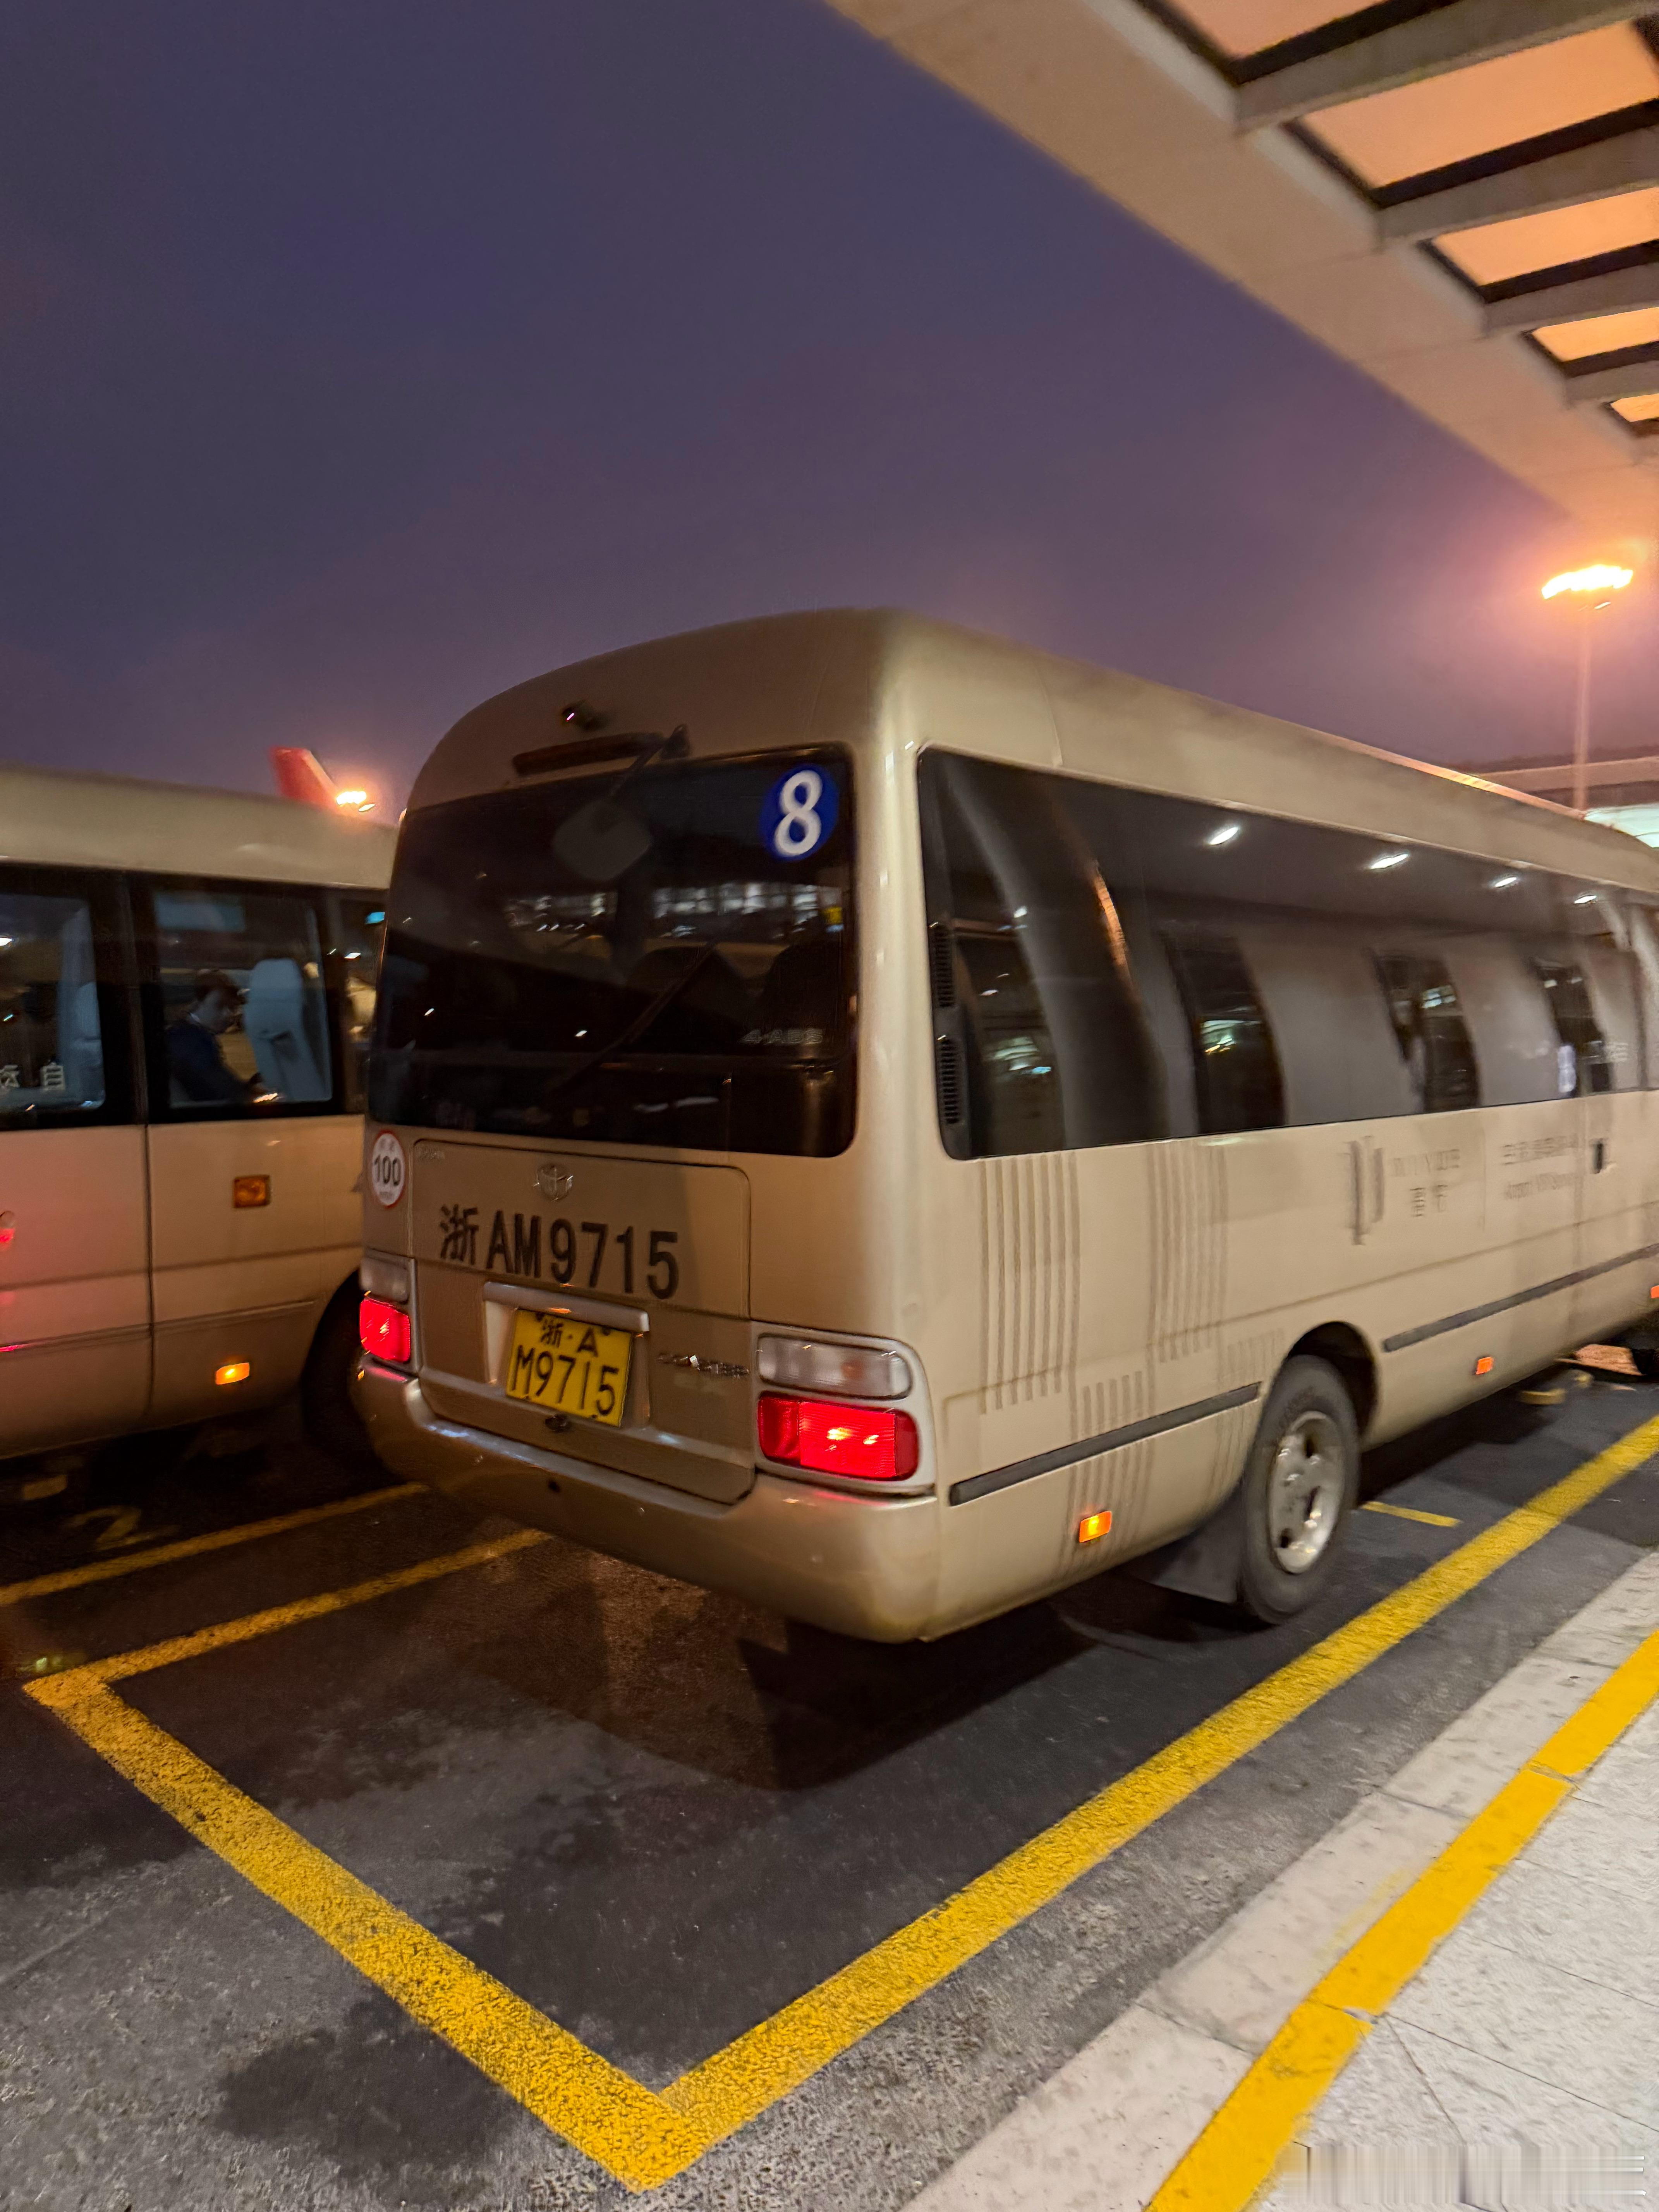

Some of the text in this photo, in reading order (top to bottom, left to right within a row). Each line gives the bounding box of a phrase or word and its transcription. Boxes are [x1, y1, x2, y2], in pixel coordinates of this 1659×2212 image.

[775, 770, 823, 857] 8
[374, 1154, 402, 1186] 100
[439, 1204, 679, 1299] 浙AM9715
[511, 1345, 619, 1415] M9715
